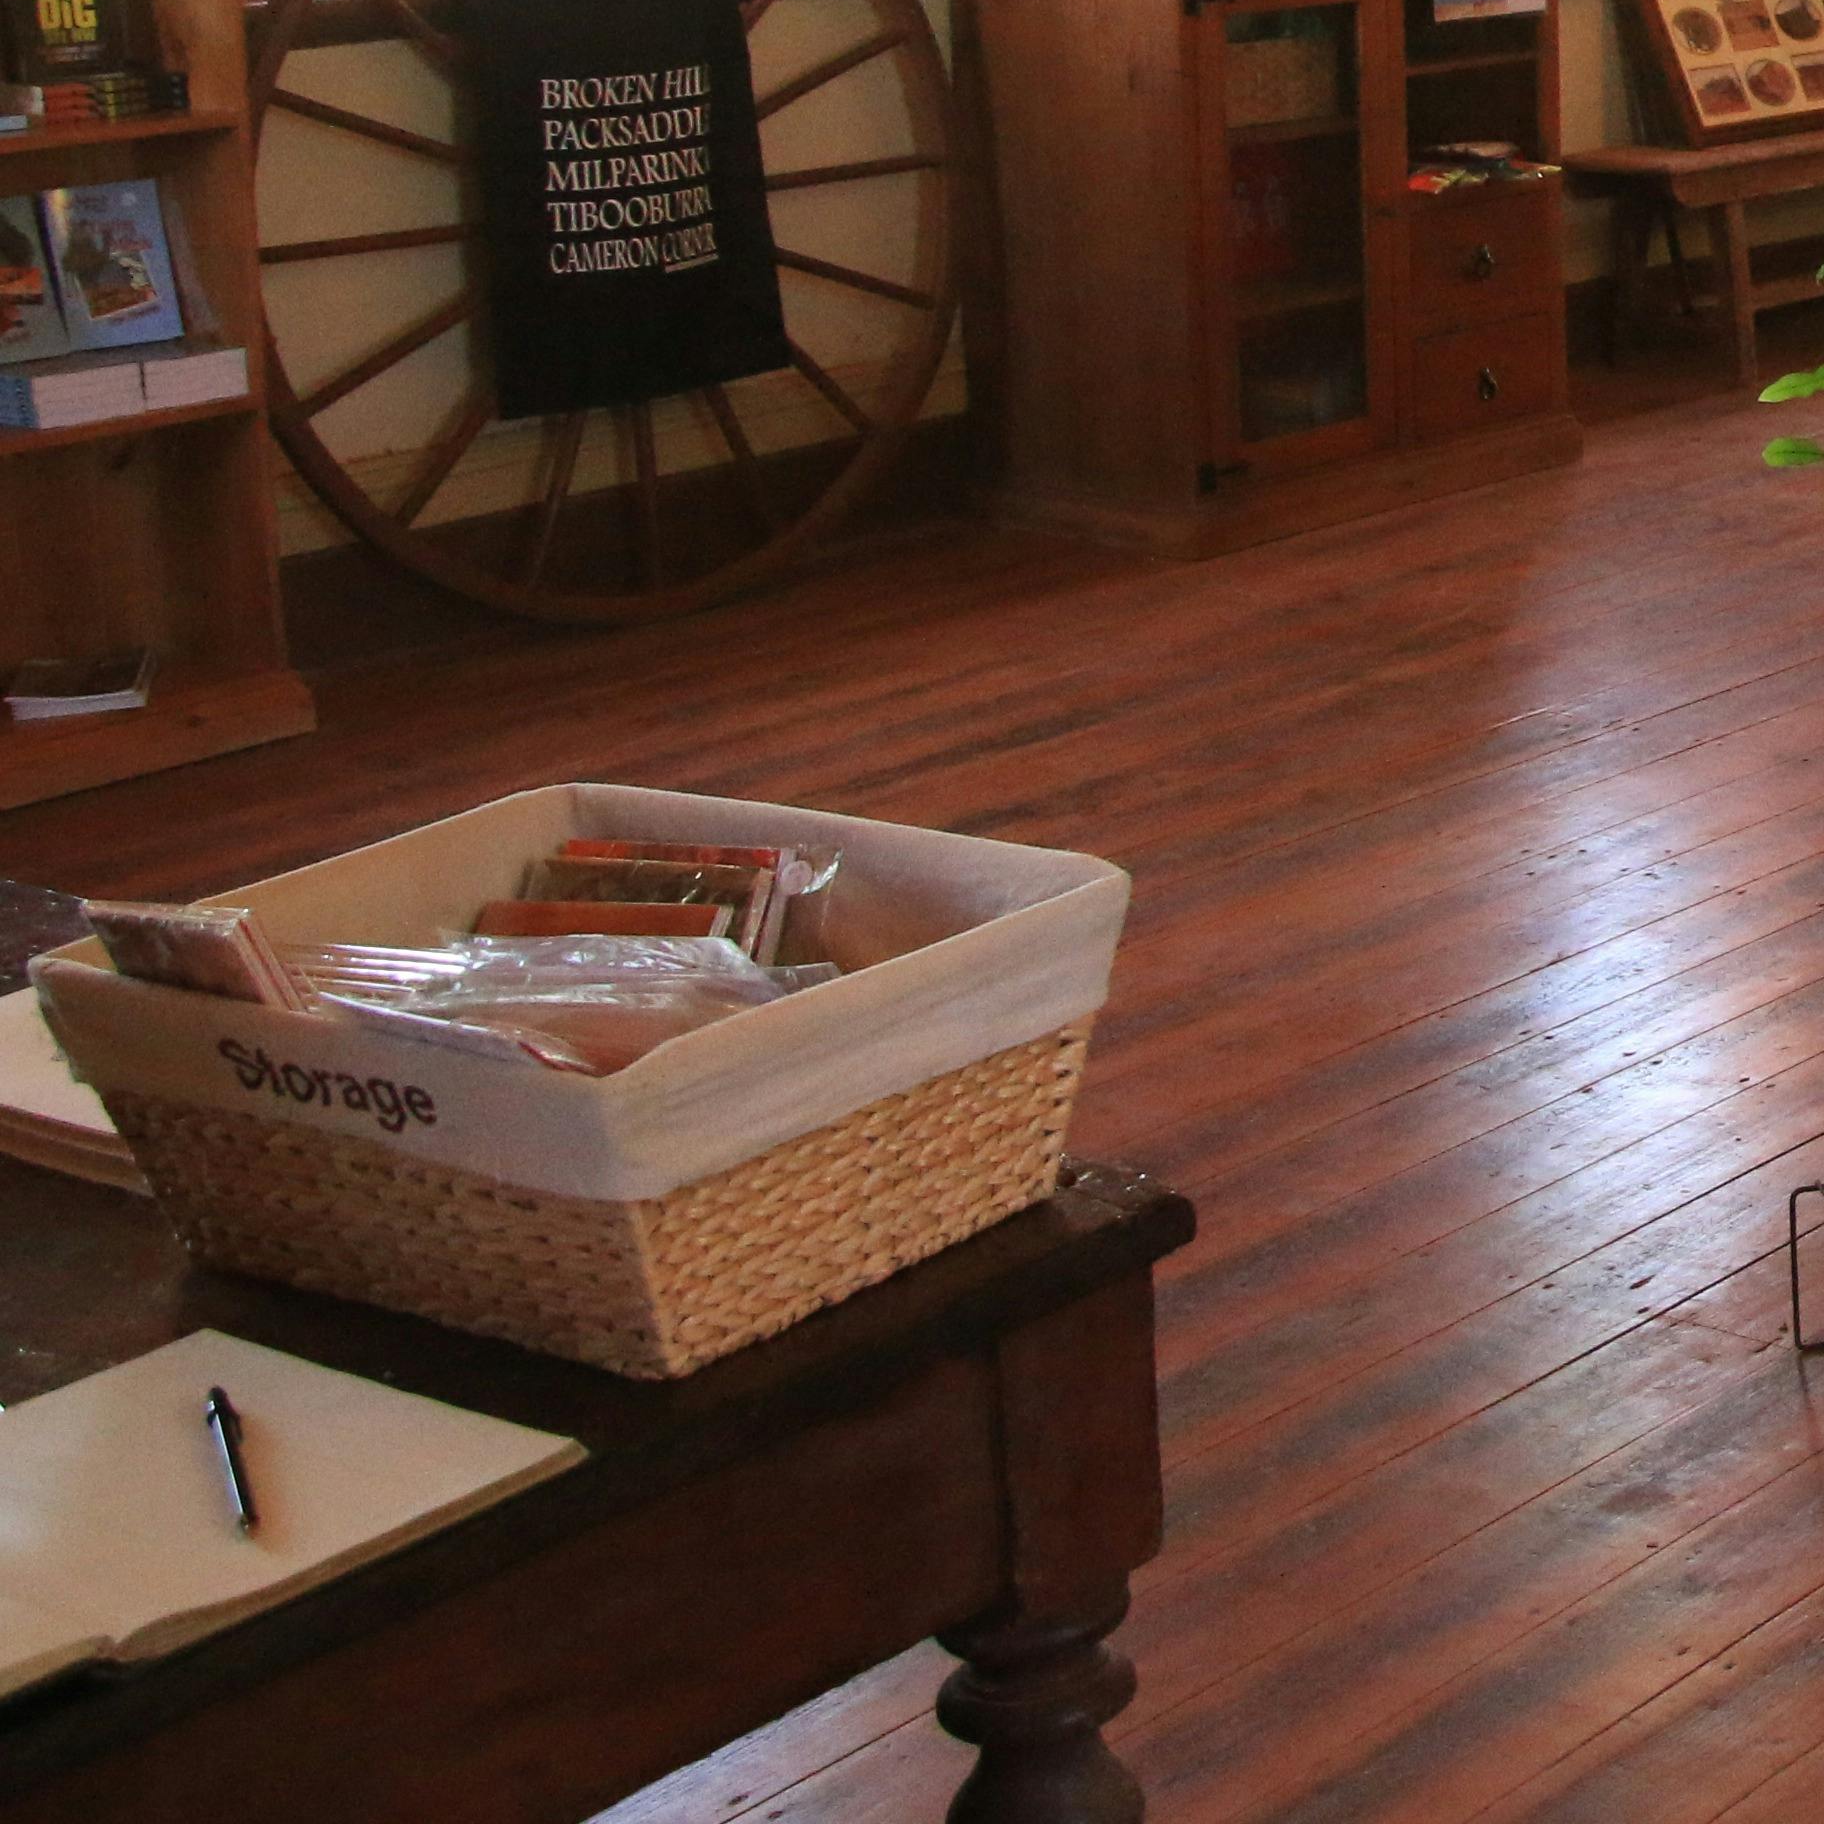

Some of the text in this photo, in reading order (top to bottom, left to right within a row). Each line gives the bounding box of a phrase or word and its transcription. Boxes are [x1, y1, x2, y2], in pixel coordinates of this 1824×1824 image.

[541, 72, 658, 110] BROKEN
[551, 236, 658, 274] CAMERON
[217, 1037, 437, 1134] Storage
